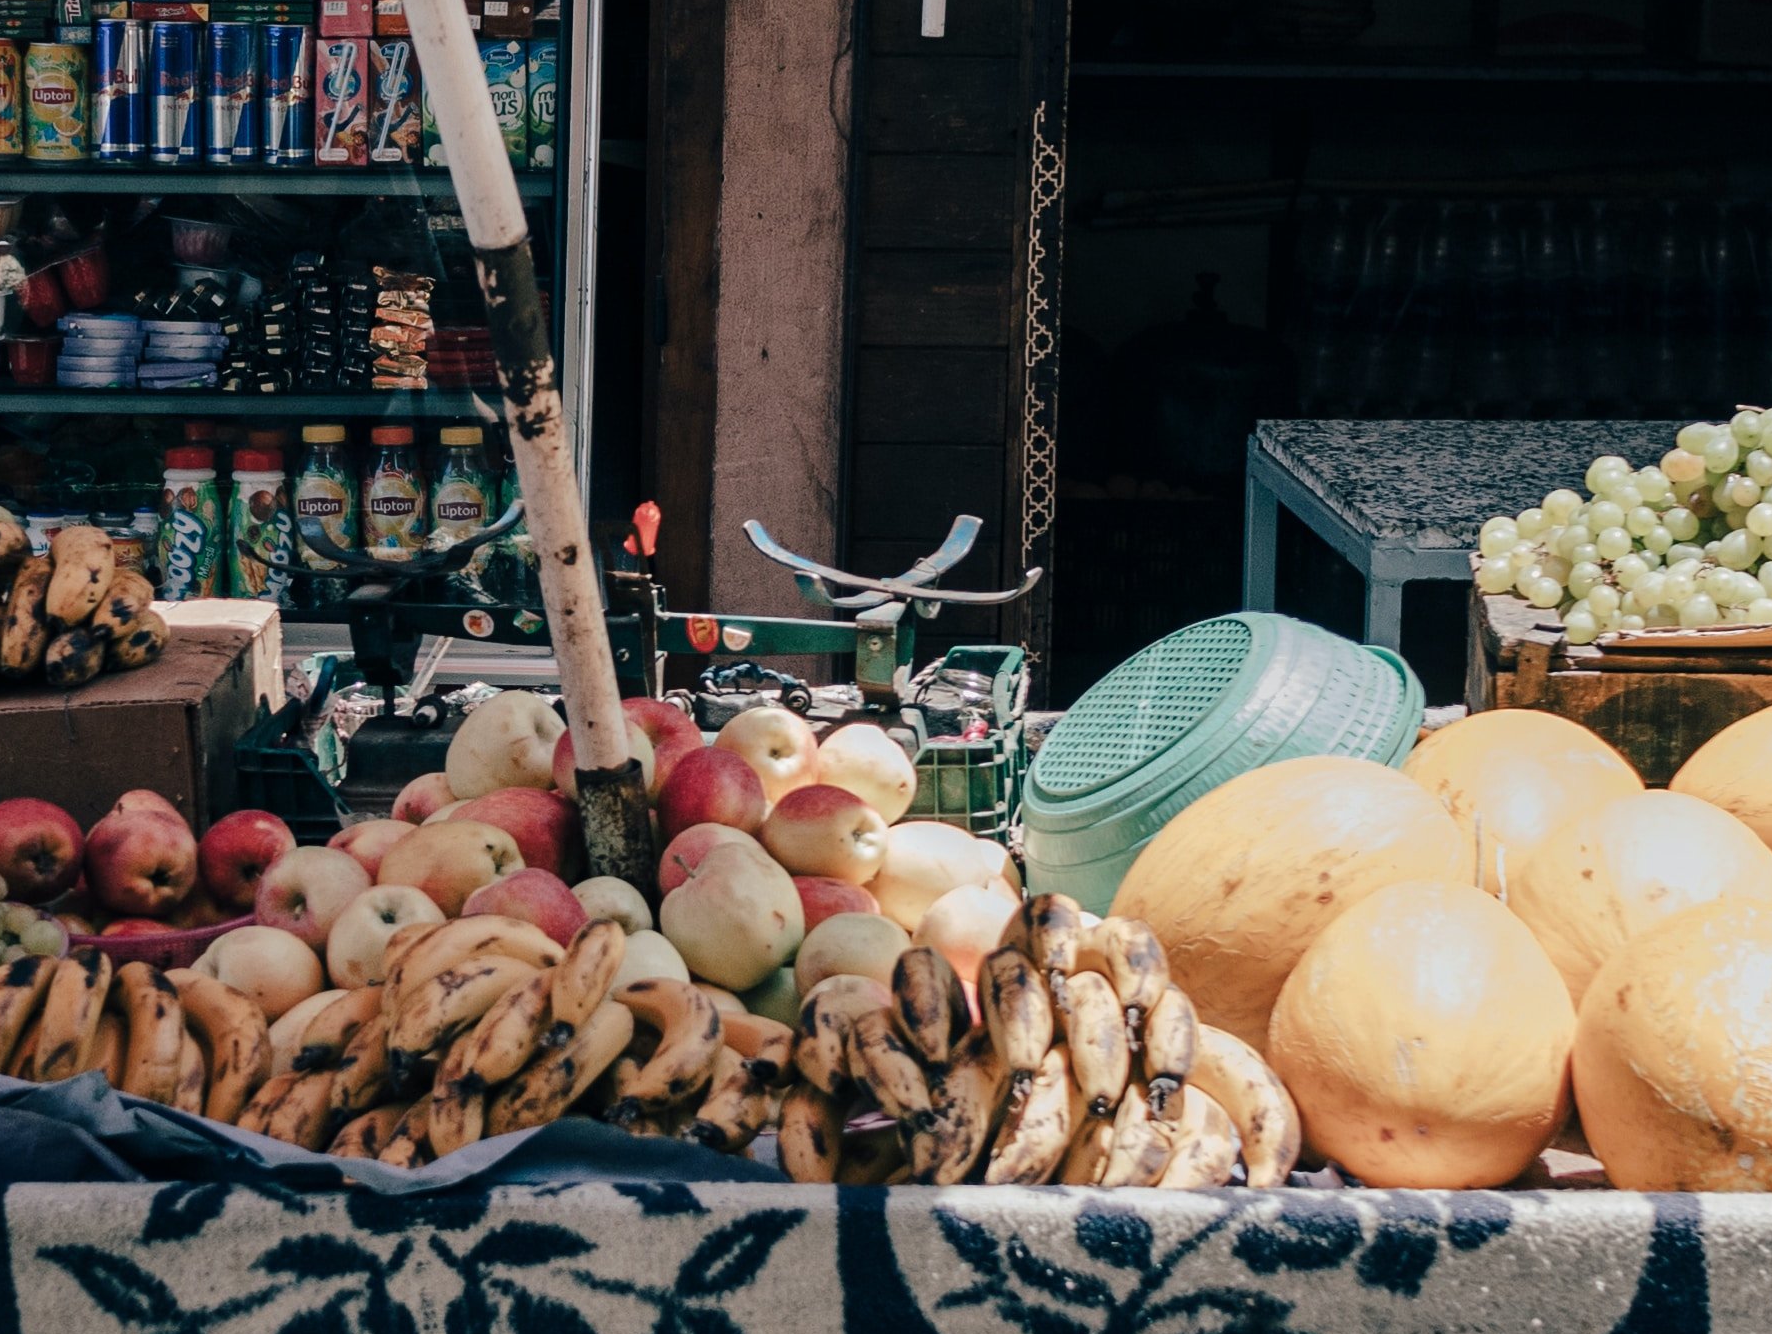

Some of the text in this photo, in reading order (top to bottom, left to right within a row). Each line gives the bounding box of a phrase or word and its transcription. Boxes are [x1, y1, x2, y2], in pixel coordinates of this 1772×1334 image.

[34, 90, 72, 103] Lipton
[300, 498, 339, 515] Lipton
[372, 497, 413, 514] Lipton
[439, 503, 479, 519] Lipton
